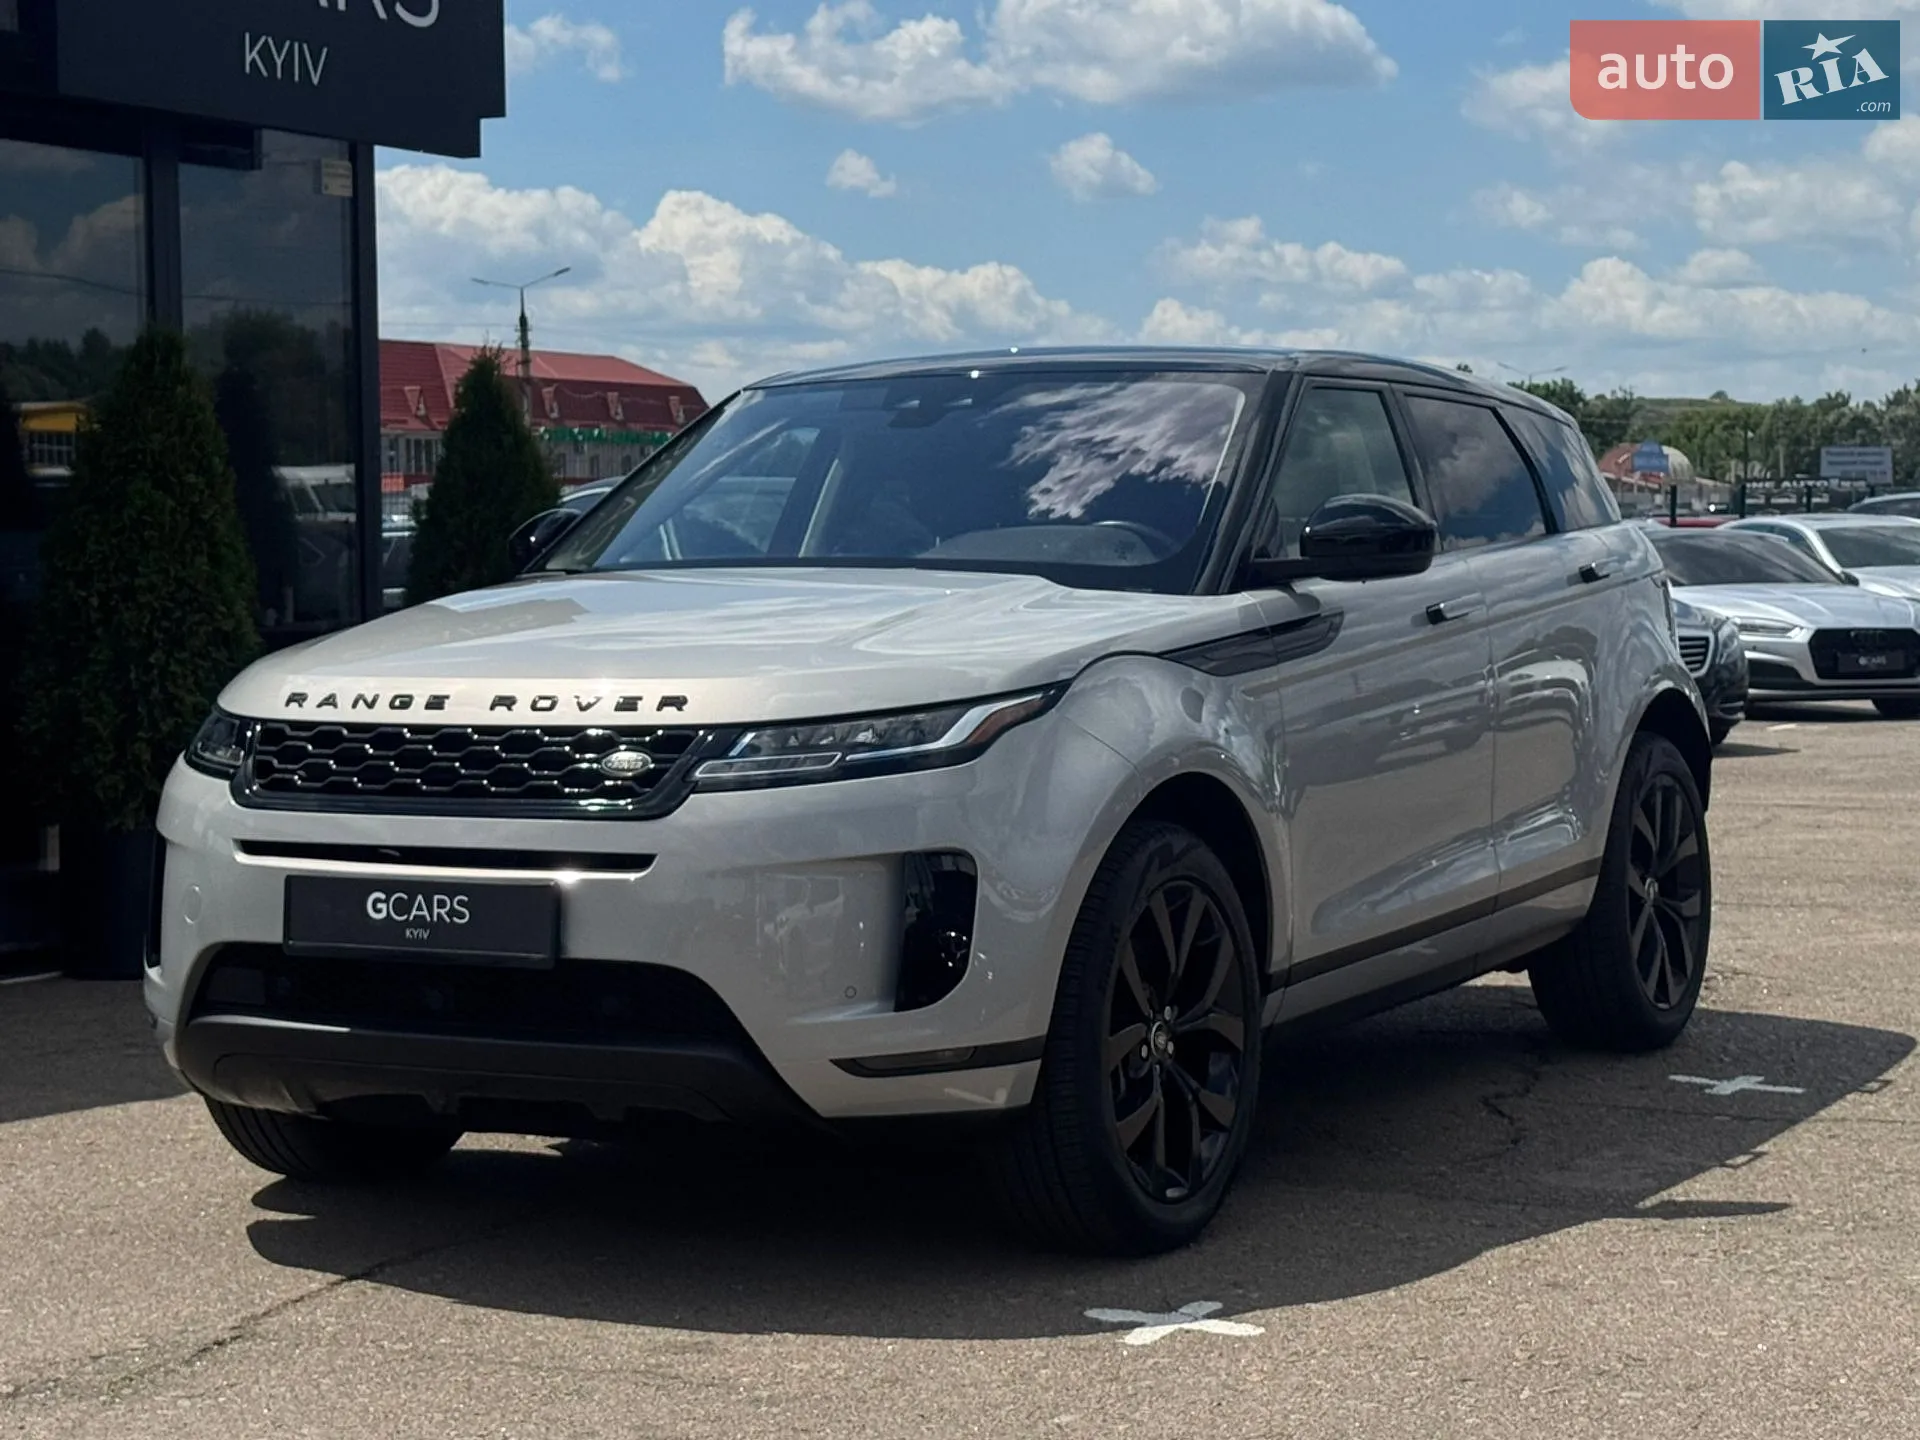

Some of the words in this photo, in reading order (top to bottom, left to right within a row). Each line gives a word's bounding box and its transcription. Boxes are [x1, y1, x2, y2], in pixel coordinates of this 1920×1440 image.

[244, 32, 328, 86] KYIV
[284, 692, 451, 712] RANGE
[489, 694, 689, 712] ROVER
[366, 891, 470, 923] GCARS
[405, 928, 430, 939] KYIV
